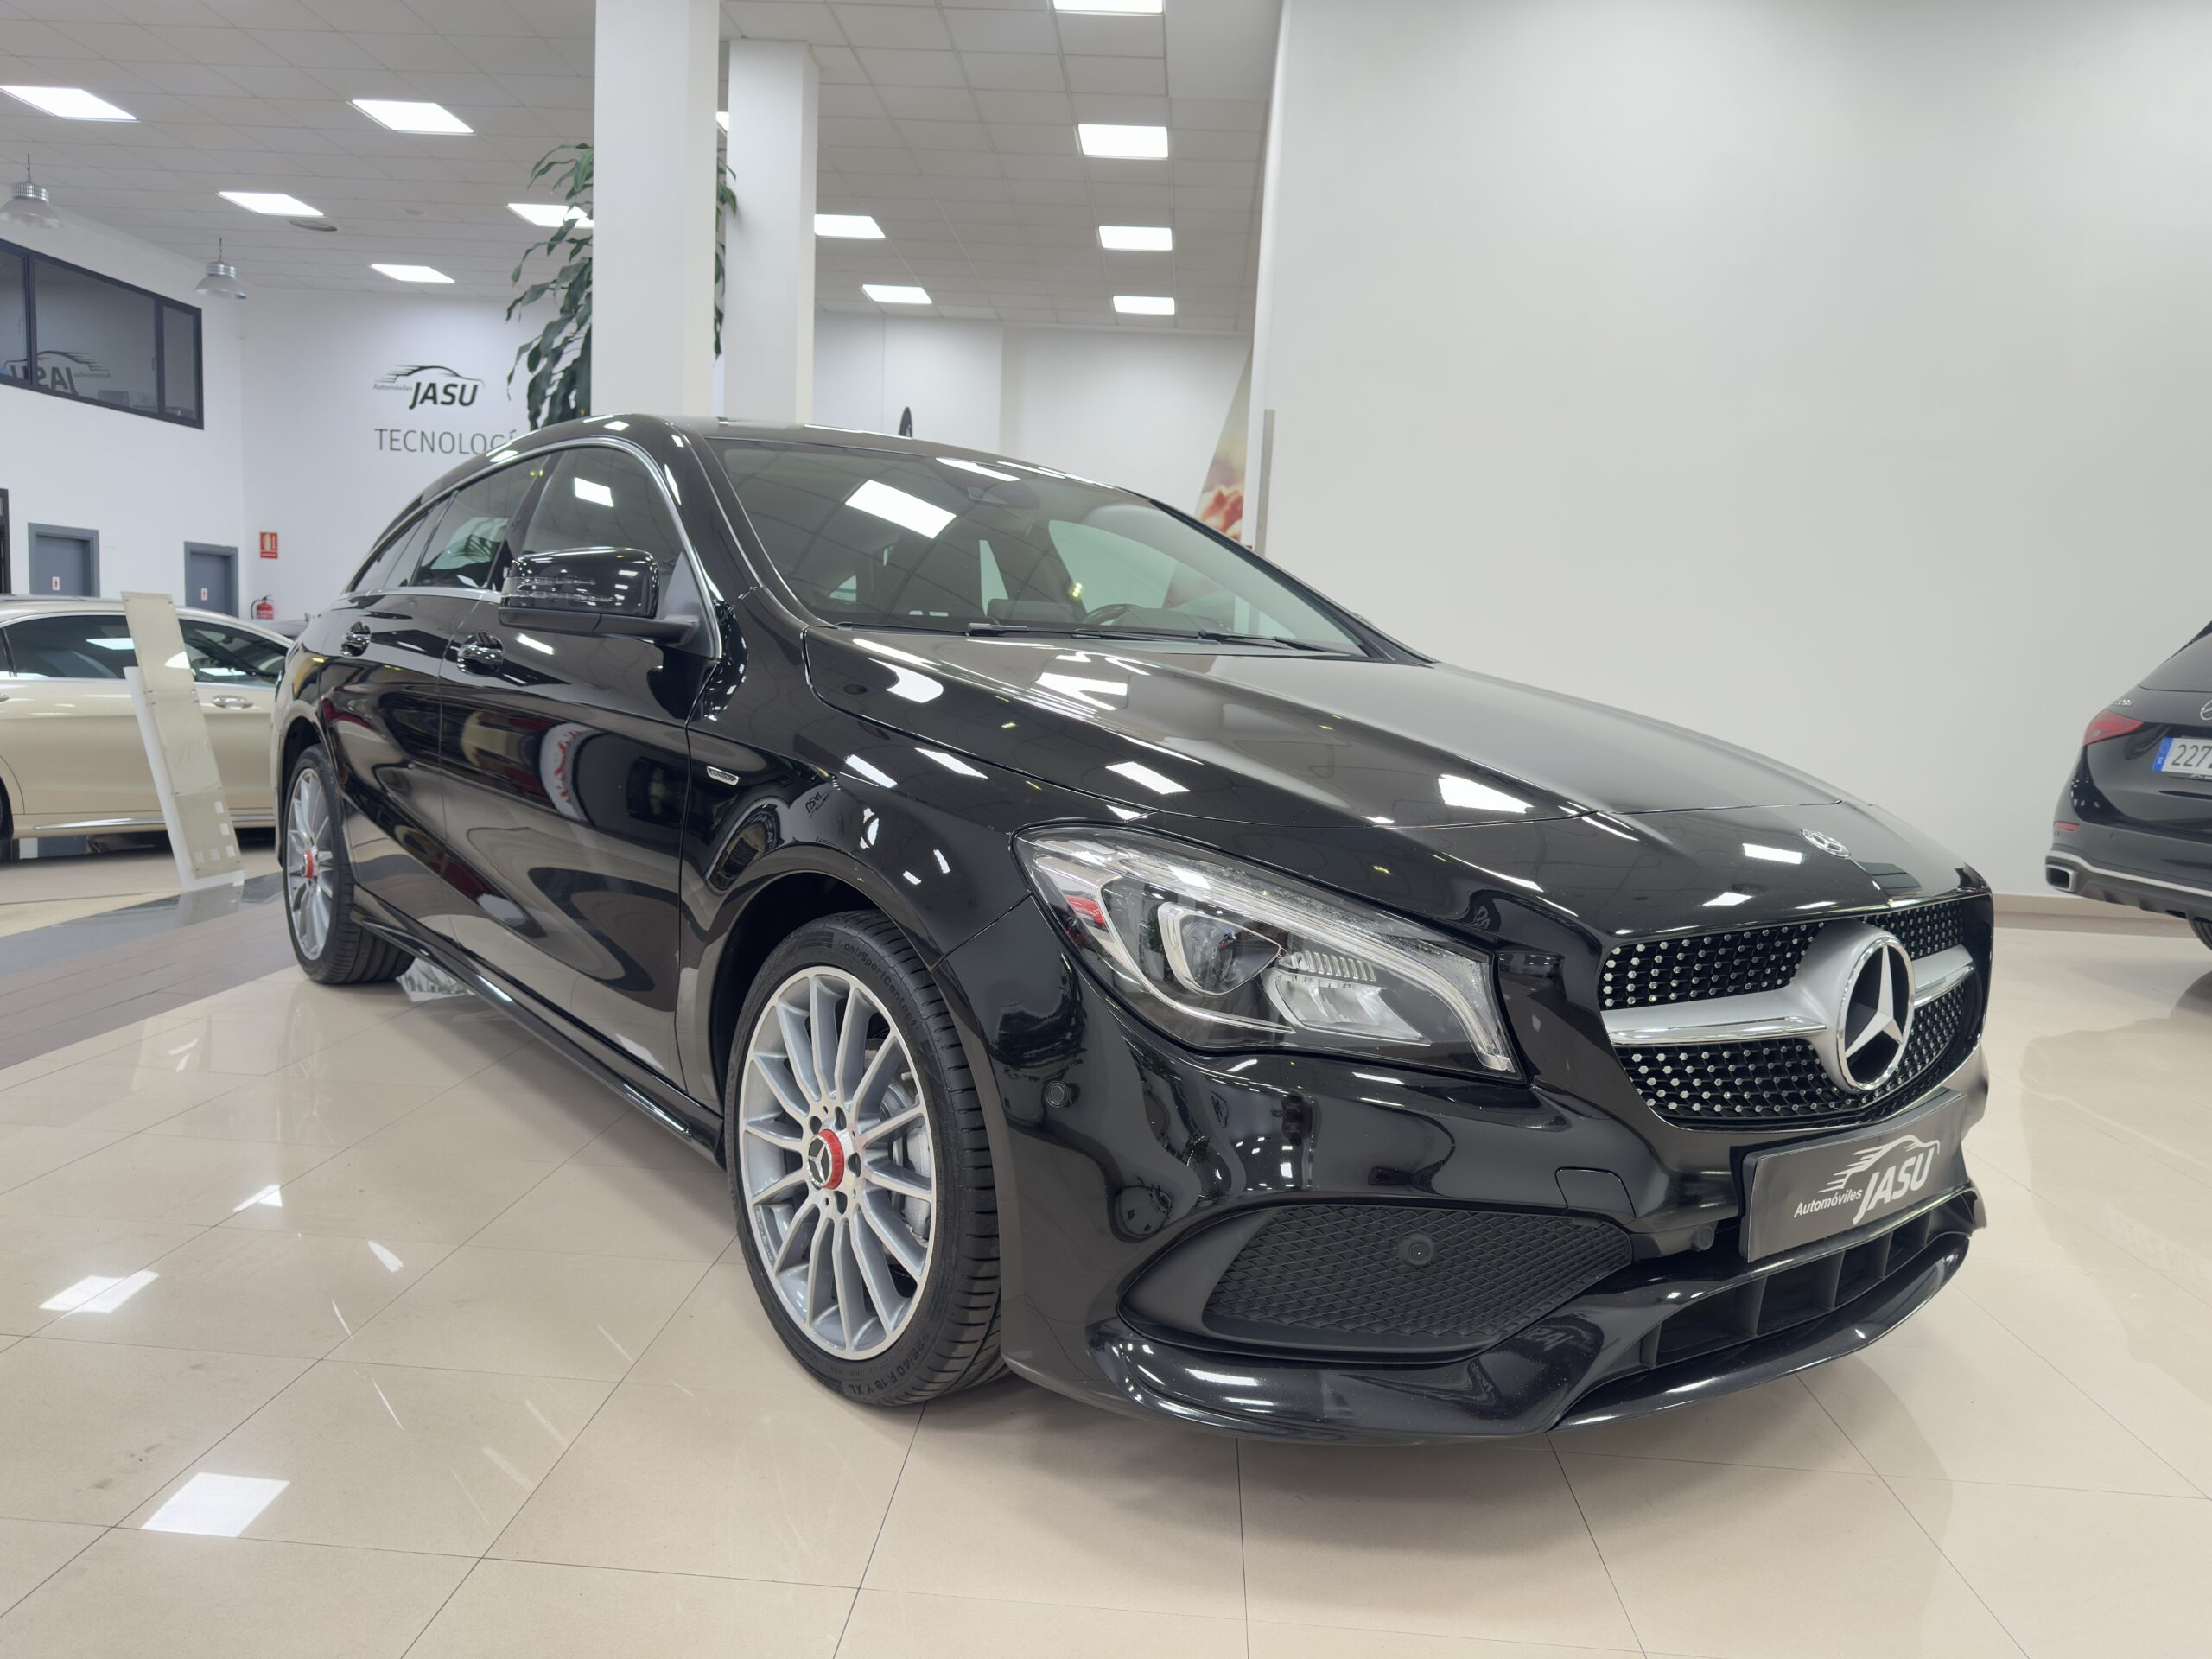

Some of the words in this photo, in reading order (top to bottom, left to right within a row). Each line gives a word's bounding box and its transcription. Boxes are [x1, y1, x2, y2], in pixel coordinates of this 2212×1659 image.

[408, 381, 479, 410] JASU
[2171, 743, 2212, 770] 227
[1794, 1188, 1863, 1217] Automóviles
[1852, 1147, 1936, 1226] JASU
